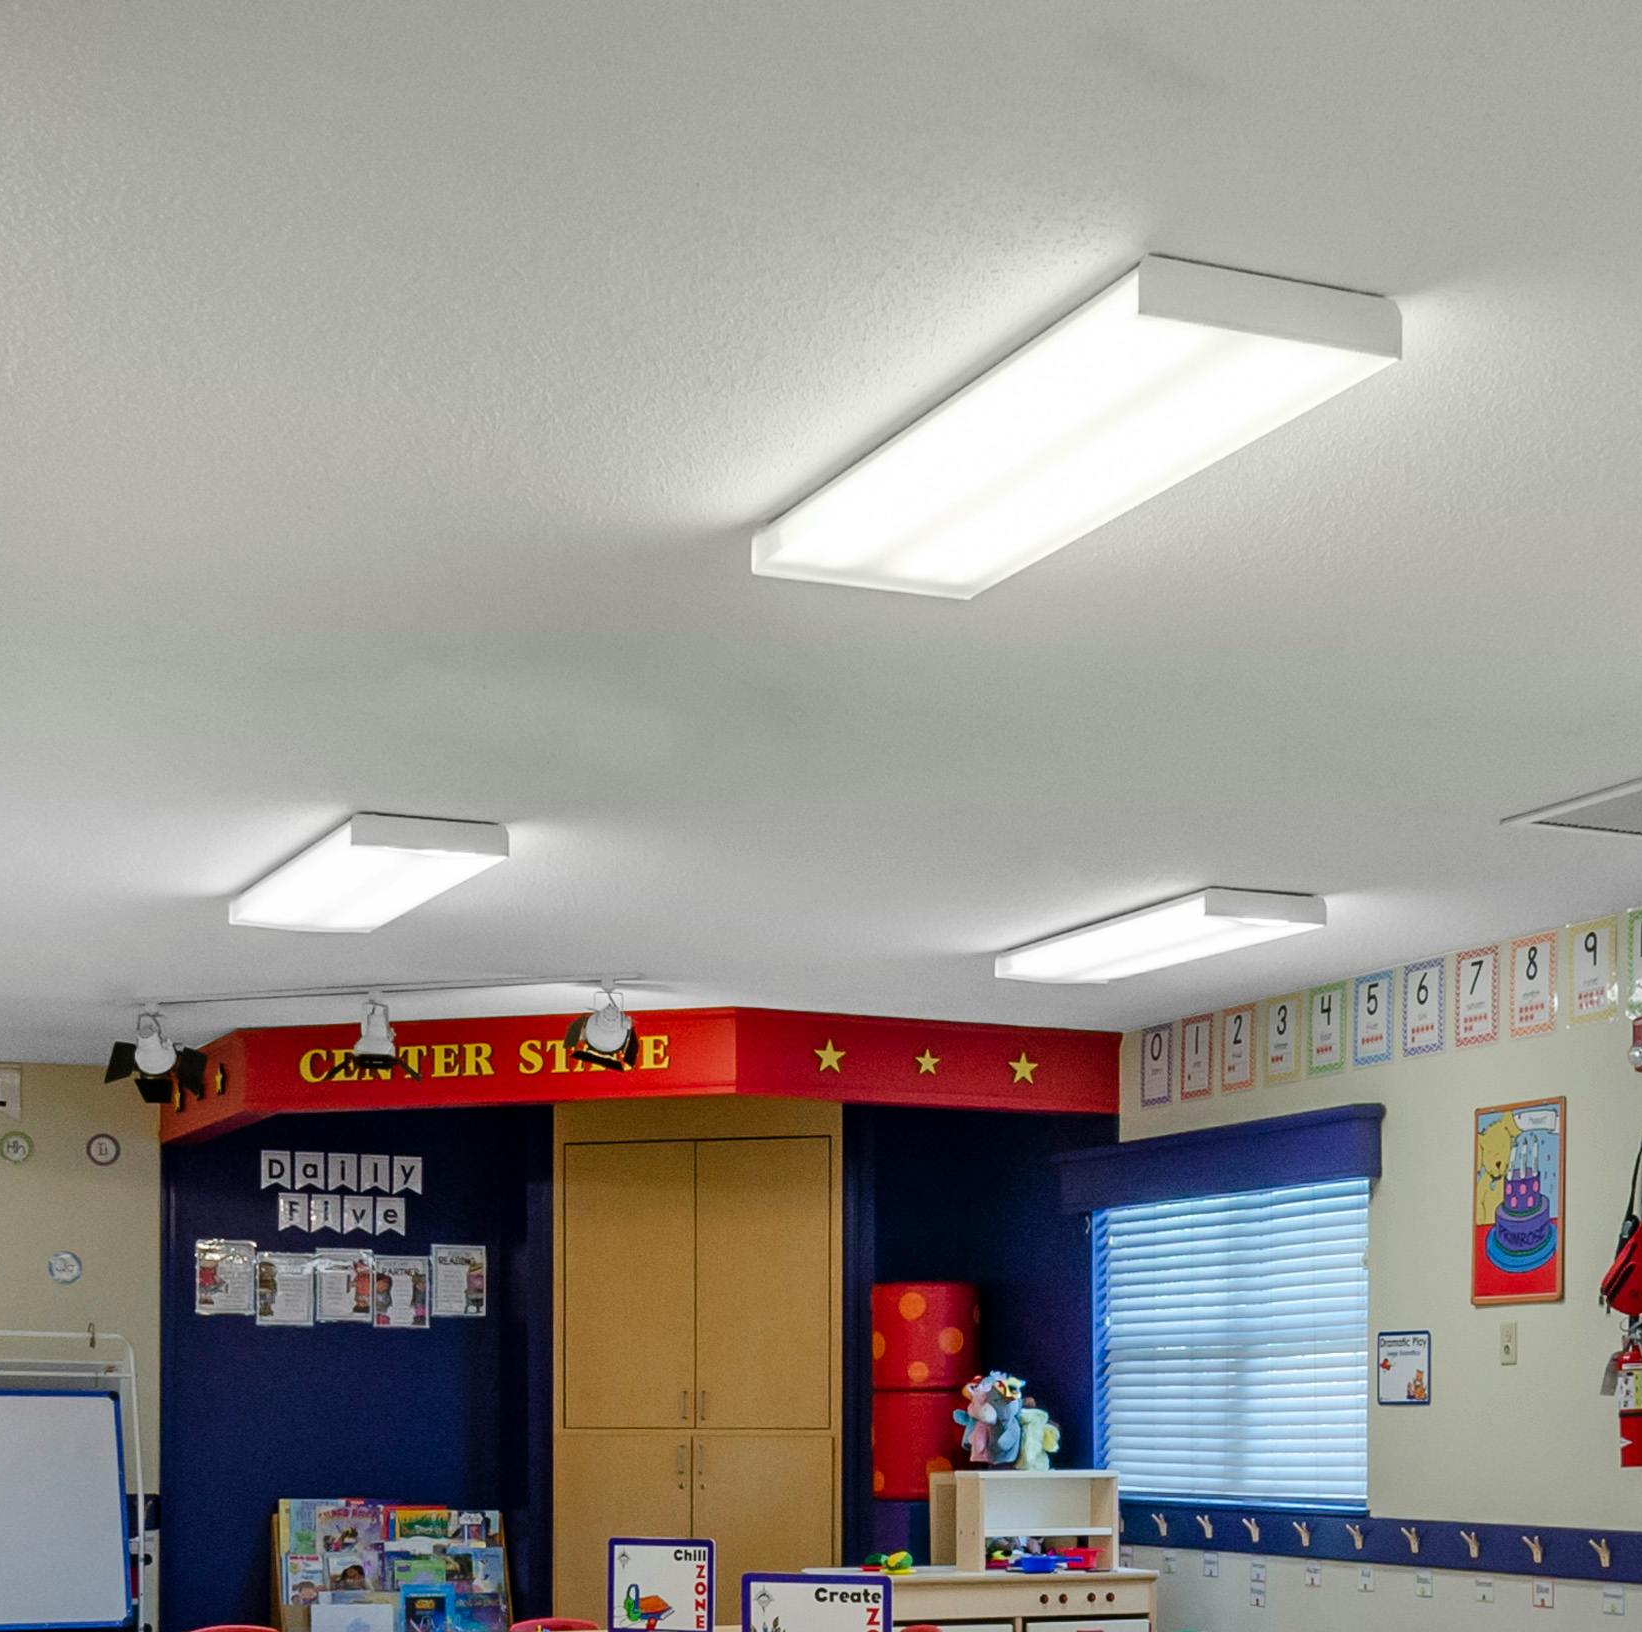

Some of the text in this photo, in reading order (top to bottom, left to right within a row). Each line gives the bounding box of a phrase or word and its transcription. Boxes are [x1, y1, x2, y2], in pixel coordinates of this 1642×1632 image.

[1525, 946, 1538, 980] 8
[1584, 931, 1597, 966] 9
[1417, 972, 1429, 1005] 6
[1470, 960, 1484, 995] 7
[1320, 994, 1332, 1025] 4
[1366, 982, 1379, 1015] 5
[1233, 1015, 1244, 1045] 2
[1276, 1005, 1287, 1035] 3
[518, 1034, 670, 1075] STE
[1150, 1033, 1162, 1061] 0
[268, 1159, 415, 1185] Daily
[288, 1201, 398, 1223] Five
[1412, 1336, 1426, 1348] Play
[673, 1549, 706, 1561] Chill
[694, 1564, 707, 1629] ZONE
[815, 1587, 882, 1603] Create
